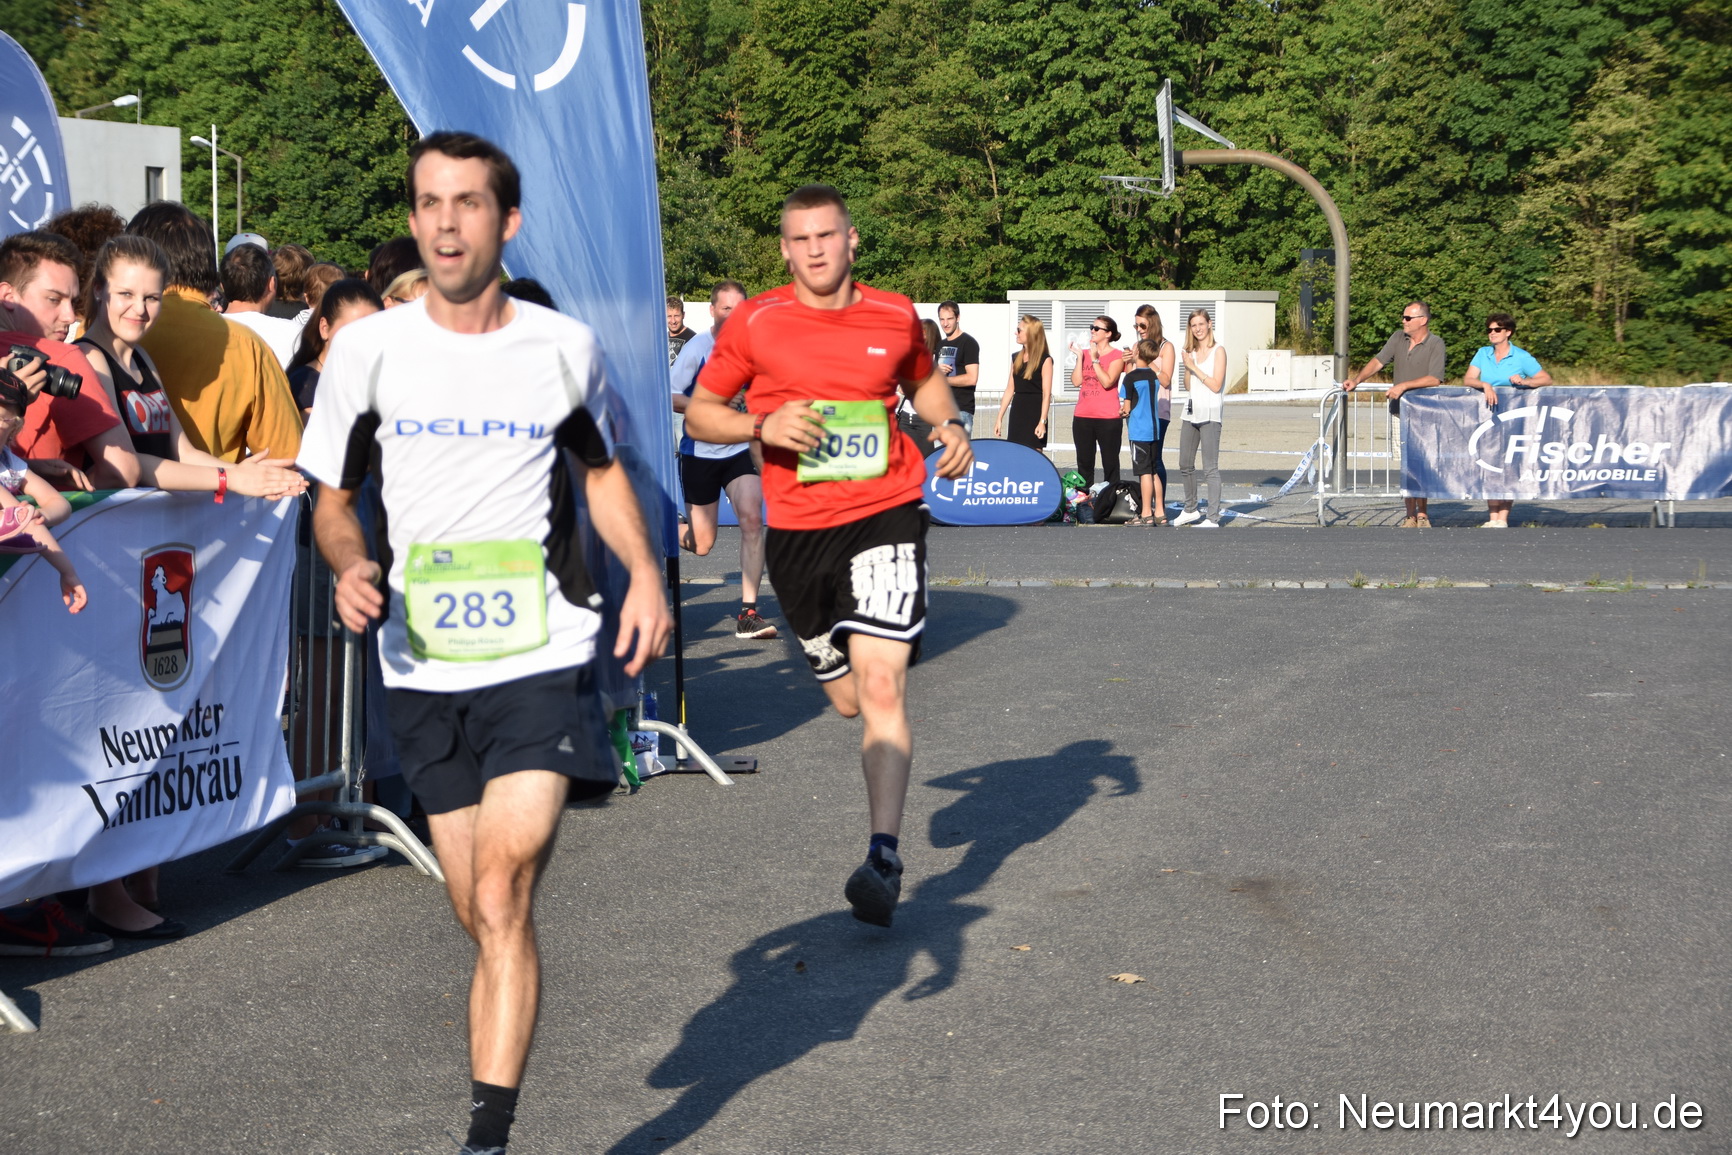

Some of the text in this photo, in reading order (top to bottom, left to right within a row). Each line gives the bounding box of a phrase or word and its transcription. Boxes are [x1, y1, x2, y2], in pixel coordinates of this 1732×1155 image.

[395, 418, 545, 440] DELPHI
[1504, 433, 1672, 464] Fischer
[952, 476, 1044, 496] Fischer
[1518, 468, 1658, 482] AUTOMOBILE
[962, 496, 1039, 506] AUTOMOBILE
[433, 590, 516, 629] 283
[153, 654, 179, 677] 1628
[99, 698, 224, 769] Neumkter
